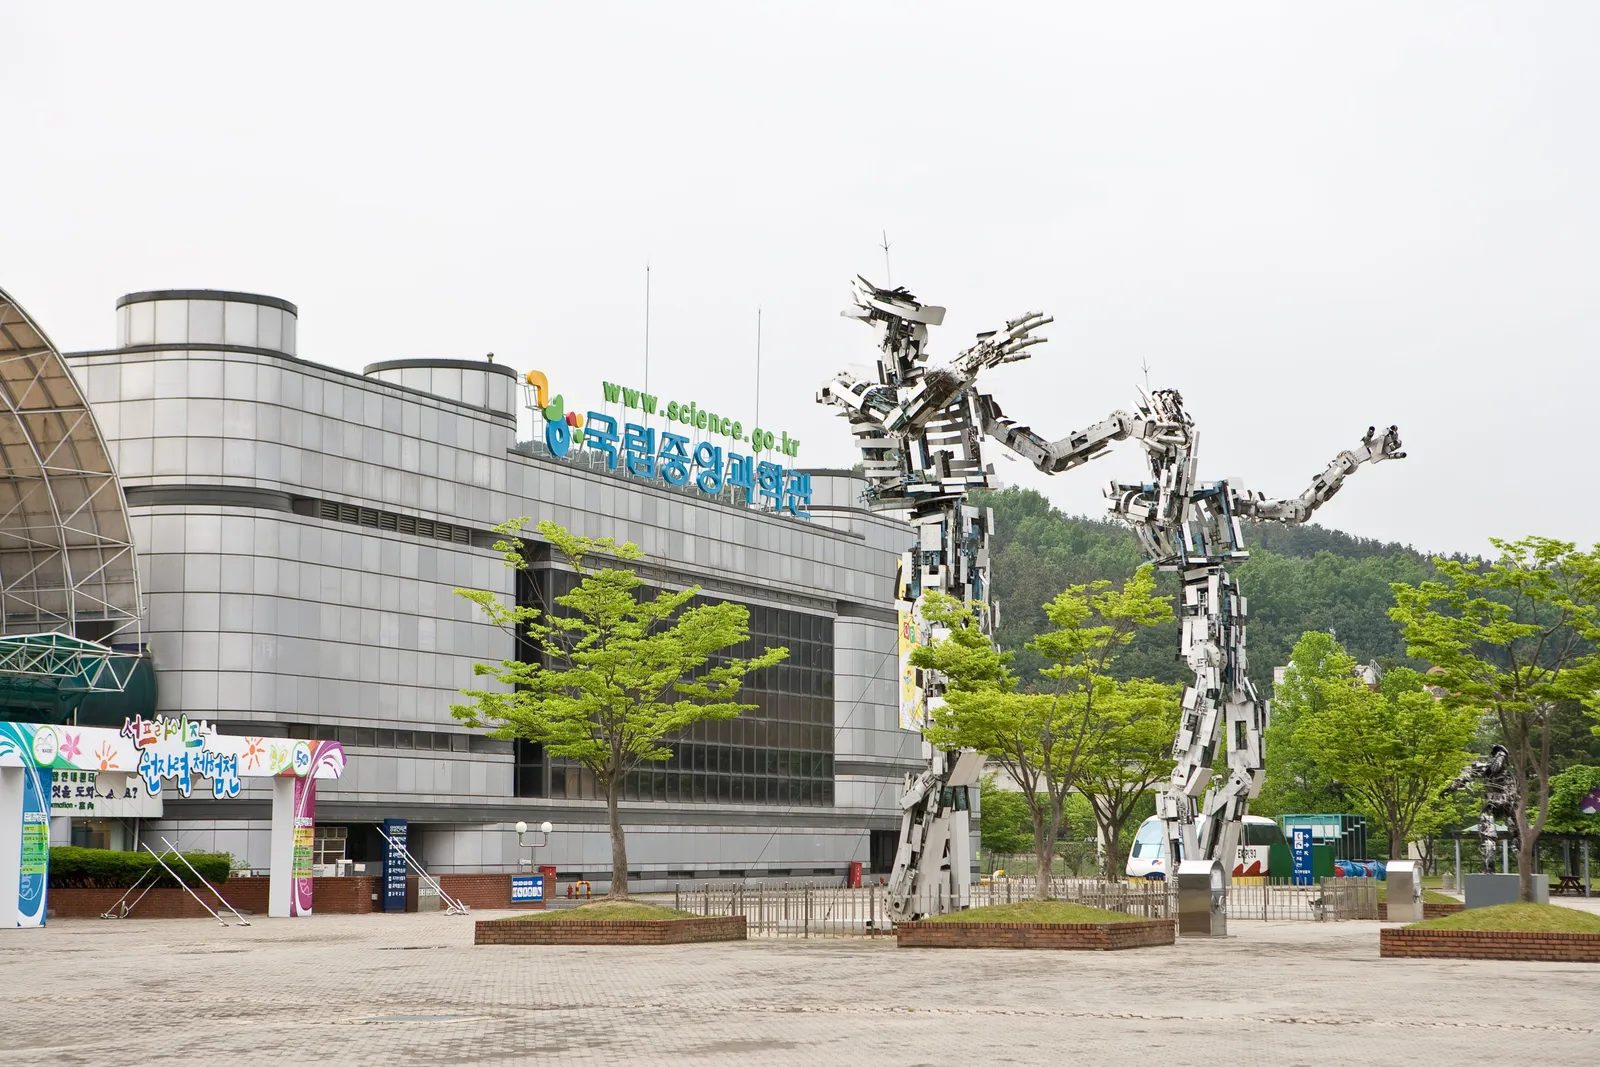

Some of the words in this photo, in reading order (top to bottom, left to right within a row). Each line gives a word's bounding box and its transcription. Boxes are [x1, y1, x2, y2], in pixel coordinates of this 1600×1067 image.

[603, 381, 800, 458] www.science.go.kr
[584, 411, 812, 519] 국립중앙과학관
[123, 715, 204, 748] 서프라이즈
[140, 751, 190, 793] 원자력
[193, 752, 240, 795] 체험전
